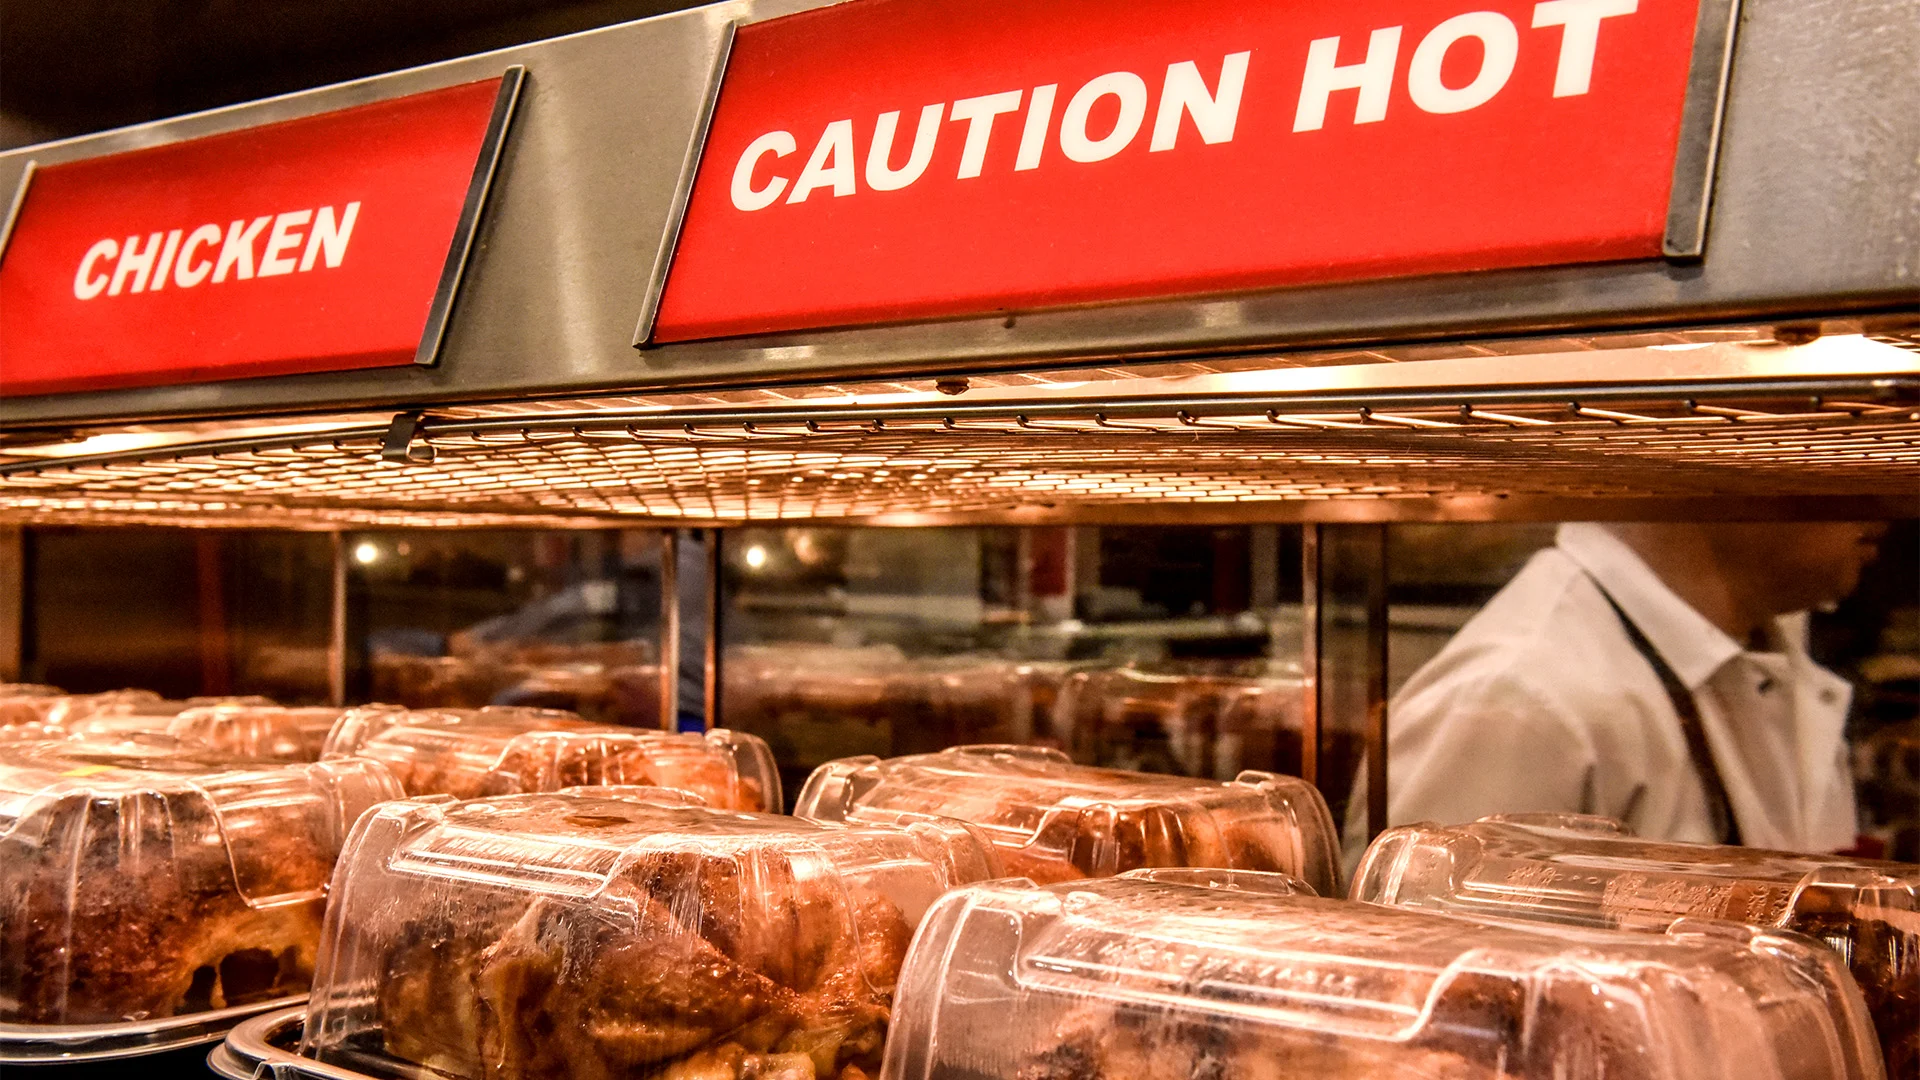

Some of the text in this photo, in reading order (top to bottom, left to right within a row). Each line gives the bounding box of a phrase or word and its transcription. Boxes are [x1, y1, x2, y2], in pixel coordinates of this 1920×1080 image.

[730, 0, 1639, 211] CAUTION HOT
[74, 201, 361, 300] CHICKEN
